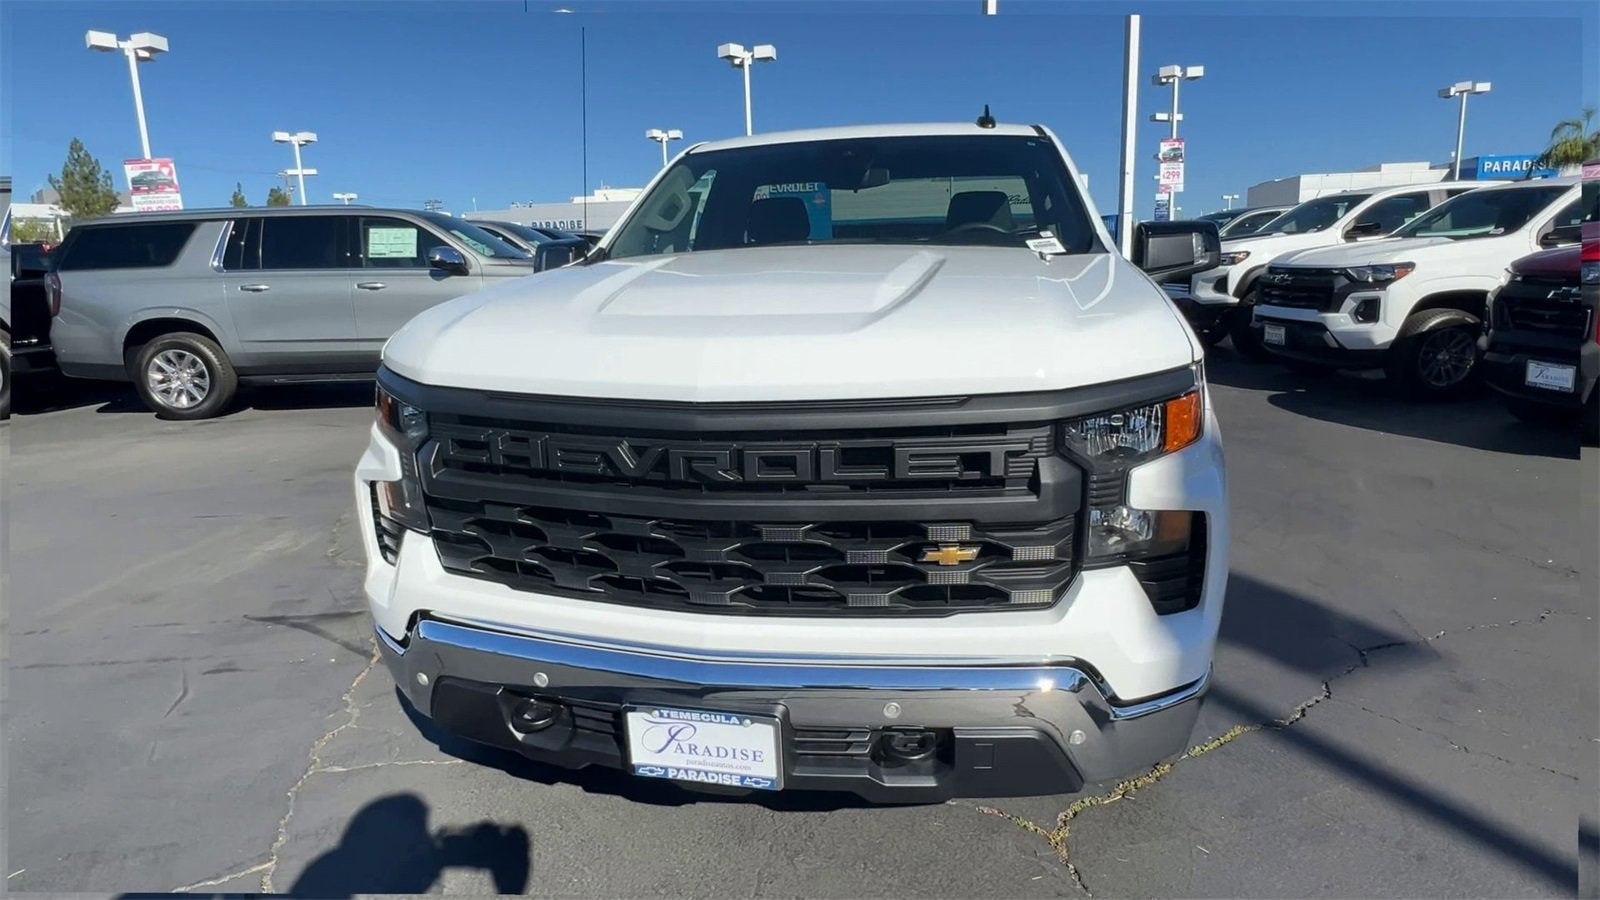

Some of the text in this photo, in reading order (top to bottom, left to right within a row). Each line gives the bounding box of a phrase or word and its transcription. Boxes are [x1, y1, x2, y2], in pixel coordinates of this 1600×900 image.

[769, 182, 819, 193] EVROLET
[531, 219, 583, 230] PARADISE
[439, 430, 1032, 483] CHEVROLET
[660, 709, 740, 725] TEMECULA
[641, 716, 764, 763] PARADISE
[667, 766, 741, 786] PARADISE
